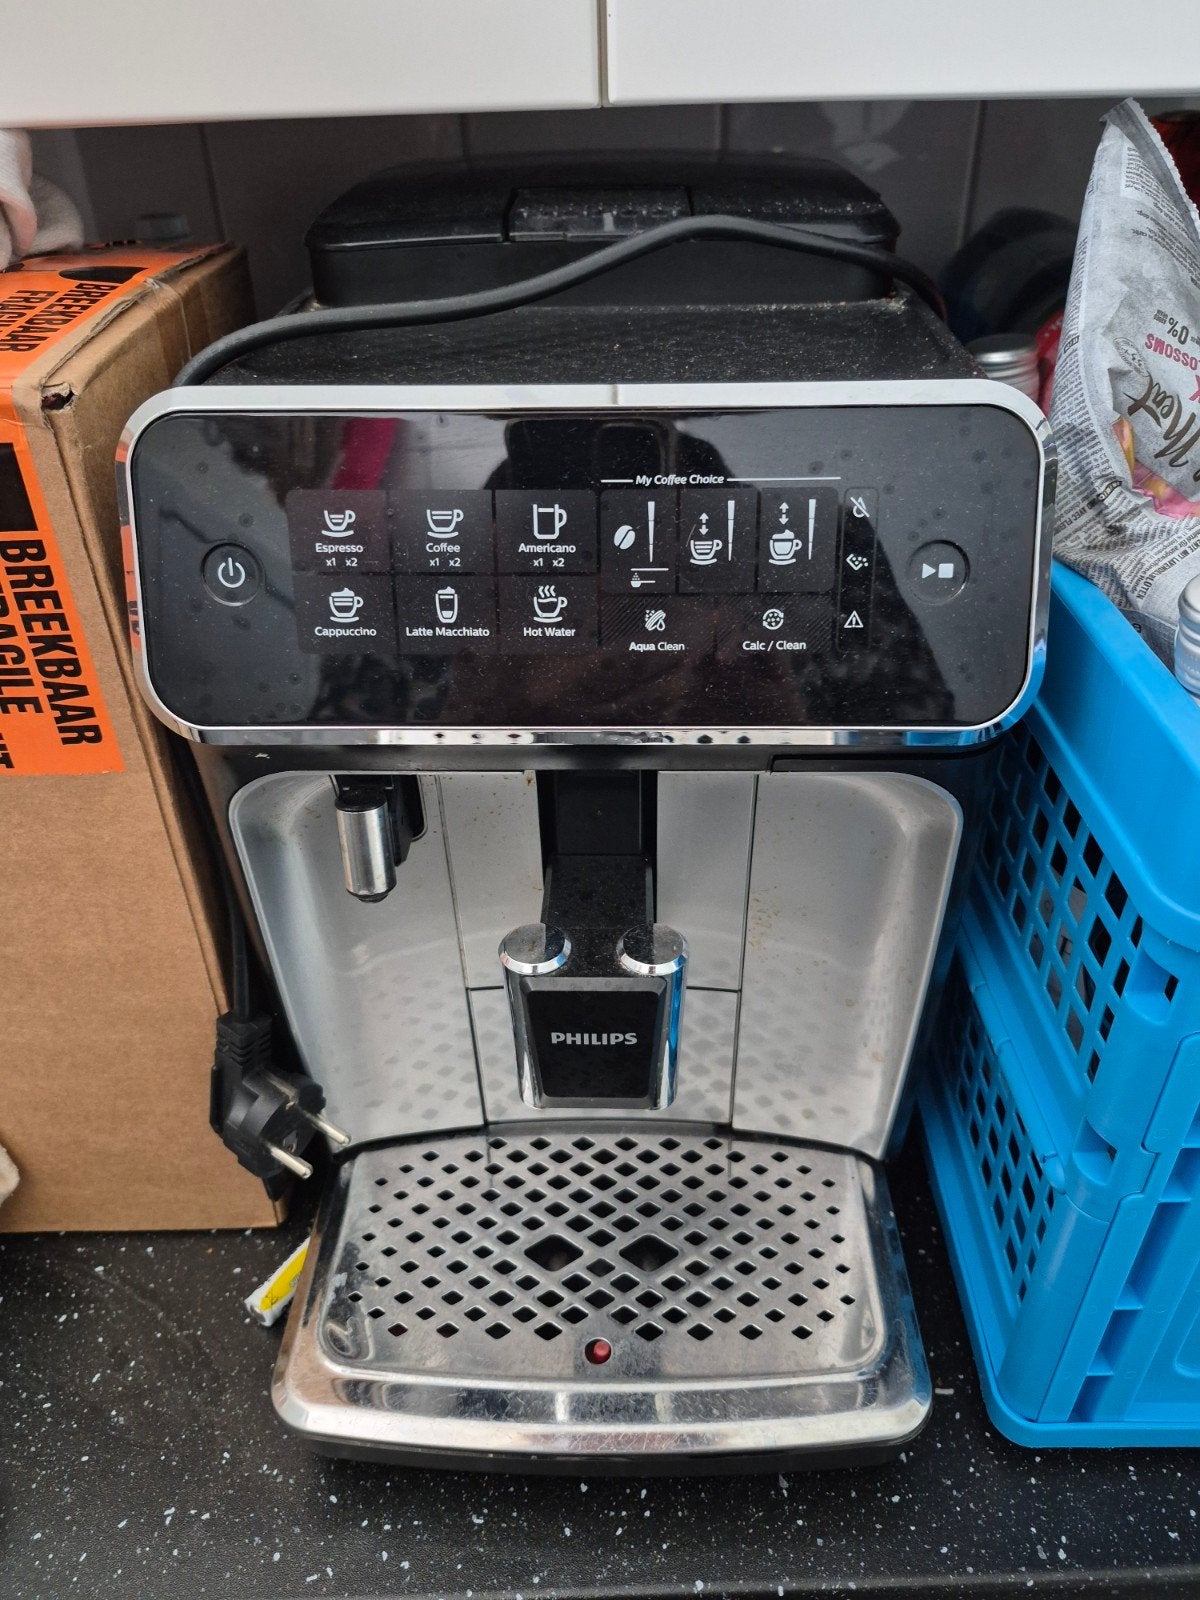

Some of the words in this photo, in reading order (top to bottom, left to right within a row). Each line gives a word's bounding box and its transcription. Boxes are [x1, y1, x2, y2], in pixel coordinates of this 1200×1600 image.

[0, 283, 120, 352] BREEKBAAR
[1167, 317, 1189, 346] 0%
[1144, 333, 1200, 371] OSSOMS
[1122, 371, 1200, 468] Meat
[635, 475, 652, 487] My
[654, 474, 687, 486] Coffee
[689, 474, 724, 484] Choice
[315, 543, 364, 554] Espresso
[426, 542, 460, 553] Coffee
[518, 543, 577, 553] Americano
[325, 557, 336, 567] x1
[345, 557, 358, 567] x2
[429, 557, 440, 567] x1
[449, 557, 461, 567] x2
[533, 557, 544, 567] x1
[552, 557, 565, 567] x2
[314, 627, 377, 637] Cappuccino
[405, 627, 433, 636] Latte
[435, 627, 490, 637] Macchiato
[523, 627, 542, 636] Hot
[545, 627, 576, 636] Water
[0, 539, 103, 746] BREEKBAAR
[628, 642, 655, 652] Aqua
[657, 642, 685, 651] Clean
[742, 641, 765, 650] Calc
[775, 641, 807, 650] Clean
[551, 1032, 638, 1045] PHILIPS
